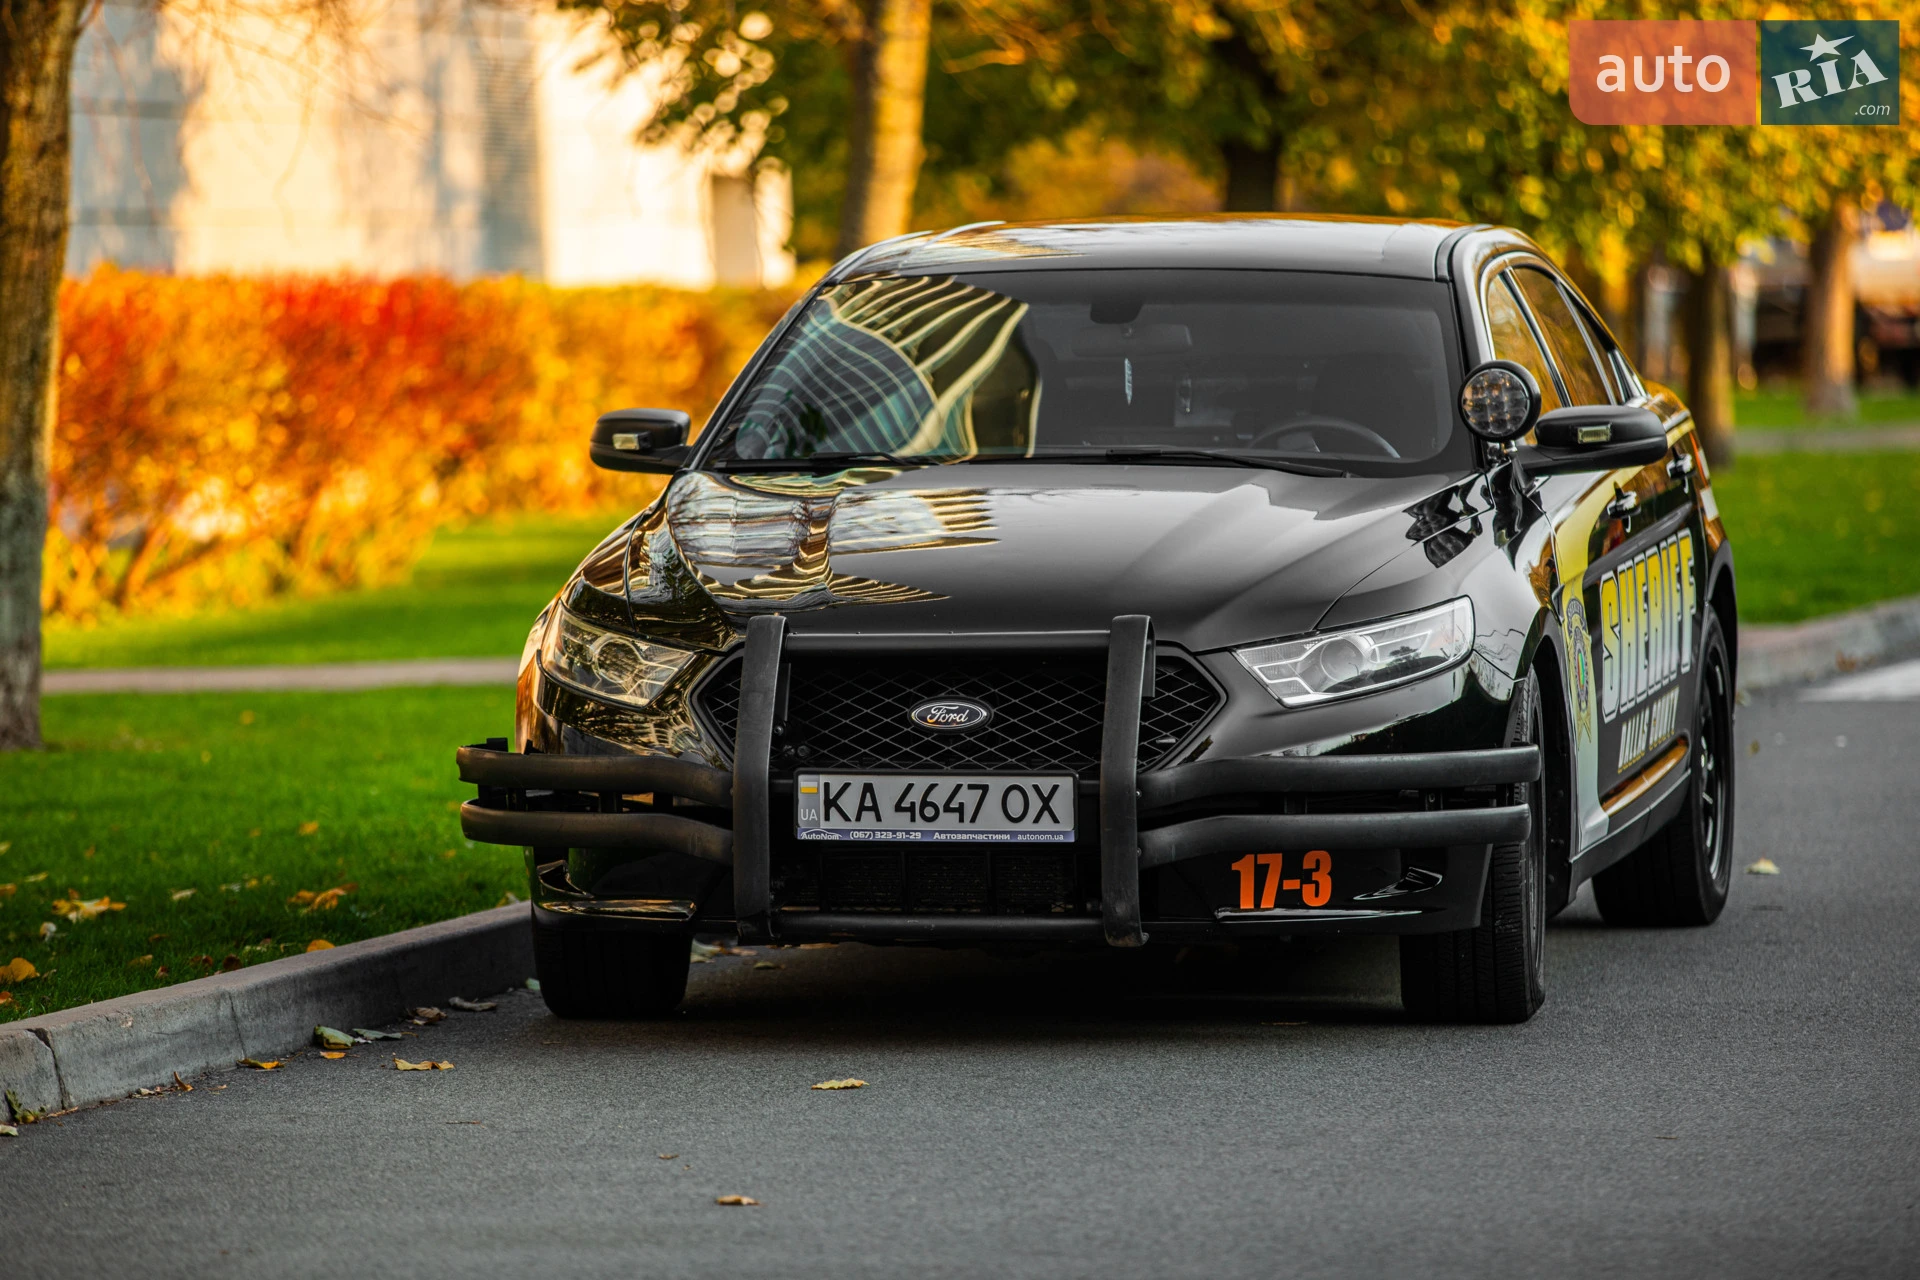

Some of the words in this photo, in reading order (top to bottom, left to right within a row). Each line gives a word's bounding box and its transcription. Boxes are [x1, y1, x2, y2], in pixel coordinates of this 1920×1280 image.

[1599, 528, 1697, 724] SHERIFF
[926, 705, 970, 724] Ford
[1617, 707, 1650, 775] DALLAS
[1648, 685, 1680, 751] COUNTY
[823, 781, 882, 823] KA
[894, 782, 990, 823] 4647
[1001, 783, 1061, 824] OX
[800, 808, 818, 821] UA
[800, 831, 840, 840] AutoNom
[849, 831, 874, 840] (067)
[875, 831, 922, 840] 323-91-29
[933, 832, 1011, 840] Автозапчастини
[1017, 833, 1064, 841] autonom.ua
[1231, 850, 1333, 910] 17-3
